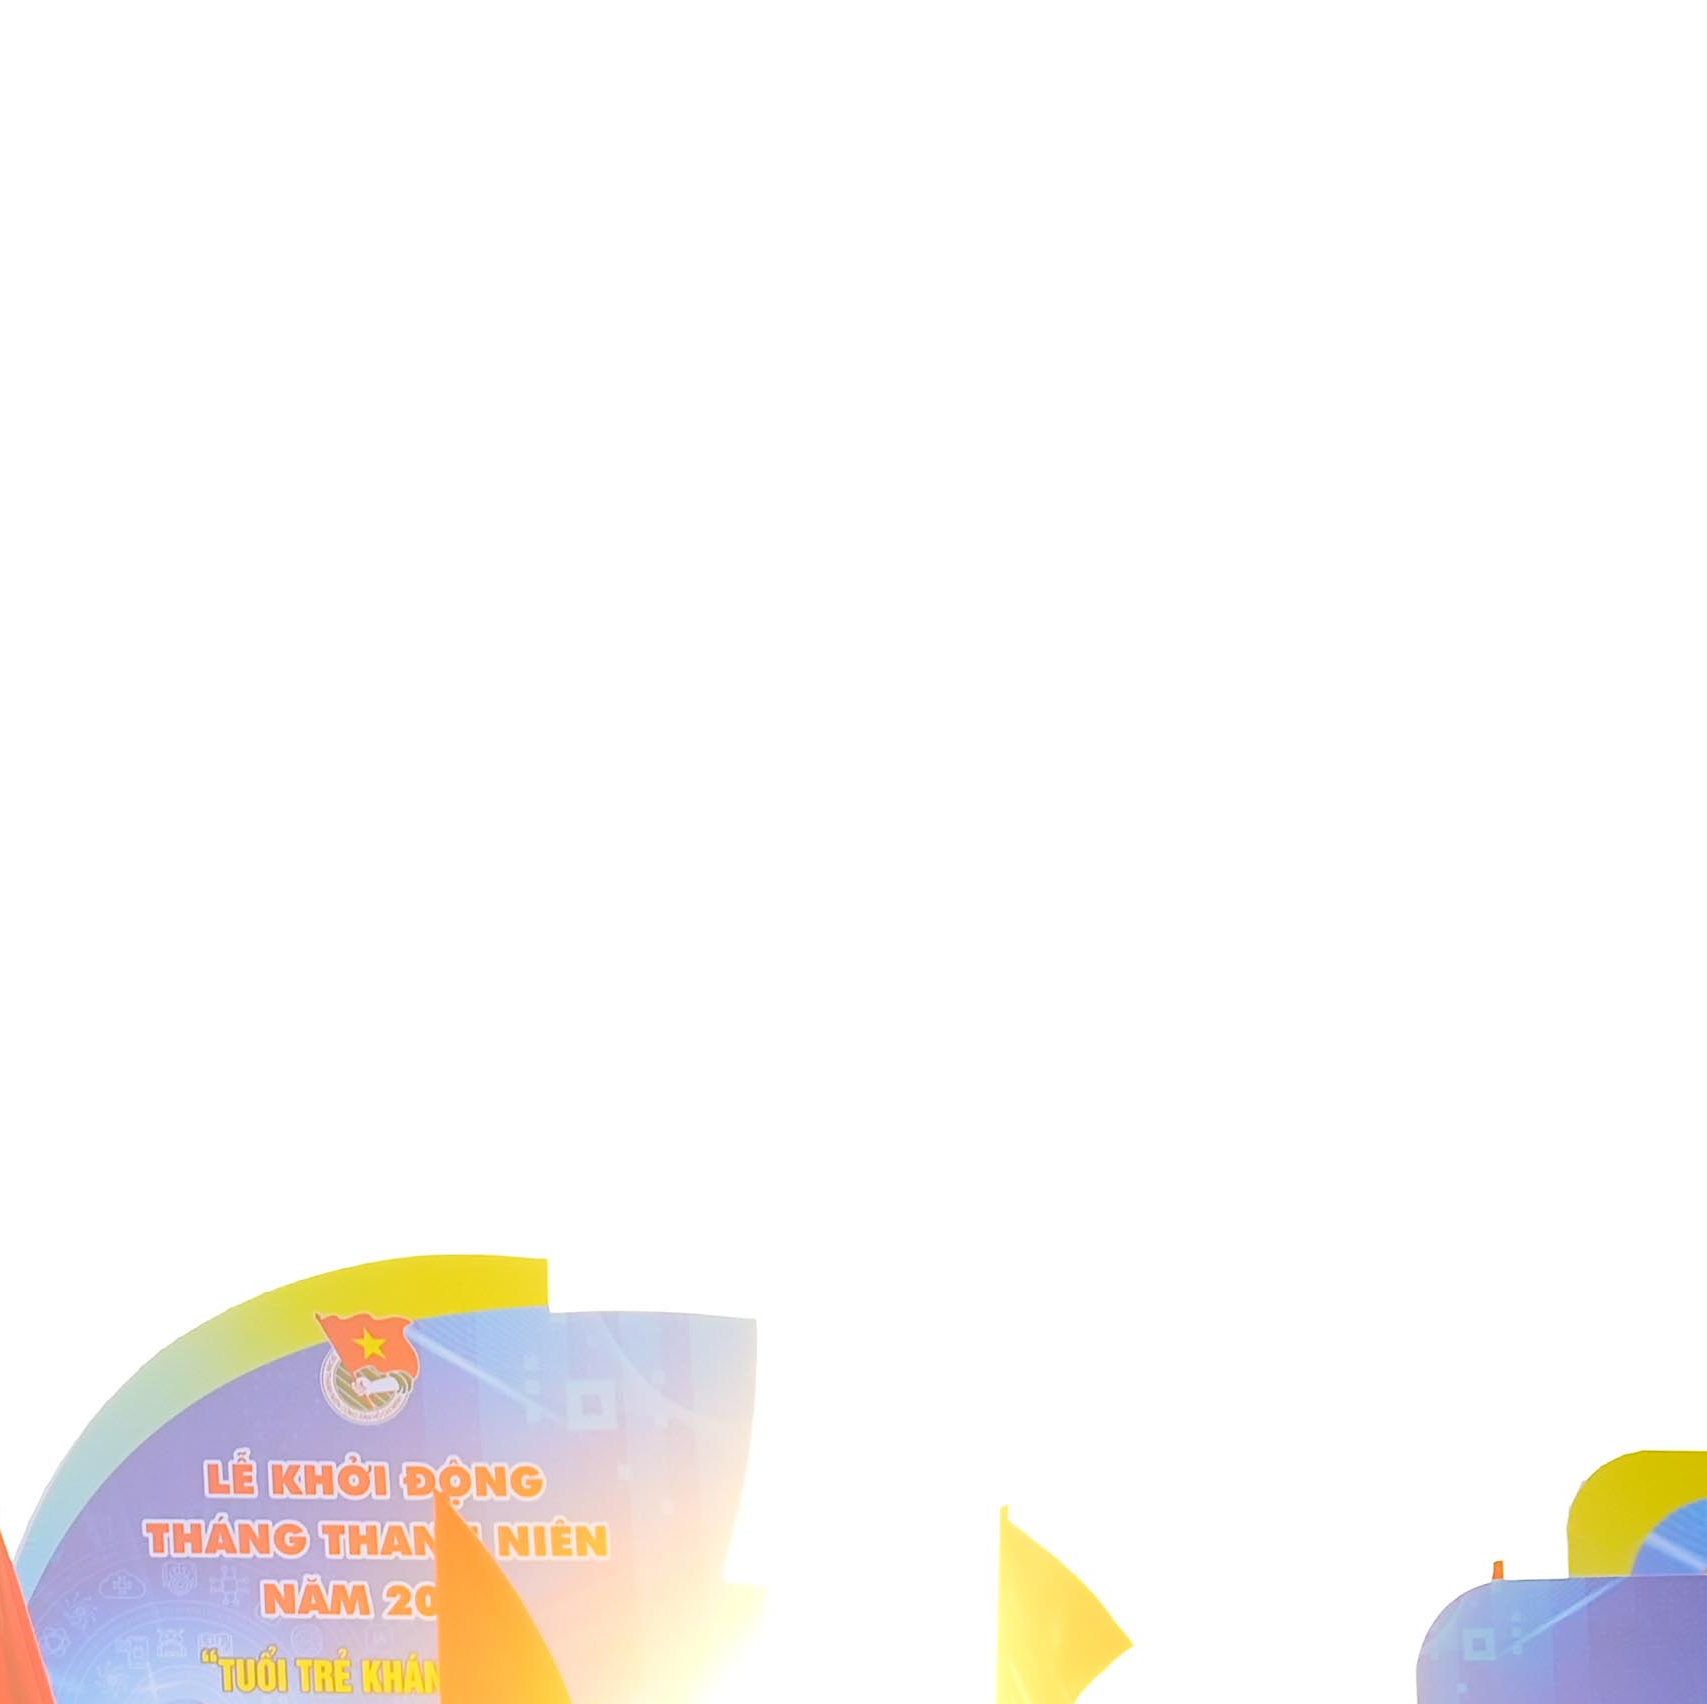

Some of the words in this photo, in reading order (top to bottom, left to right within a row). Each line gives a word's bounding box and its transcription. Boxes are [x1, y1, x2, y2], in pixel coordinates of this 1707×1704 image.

[205, 1450, 257, 1496] LỄ
[270, 1455, 389, 1497] KHỞI
[402, 1458, 545, 1505] ĐỘNG
[145, 1513, 309, 1557] THÁNG
[320, 1522, 481, 1559] THAN
[497, 1518, 609, 1558] NIÊN
[262, 1574, 372, 1617] NĂM
[384, 1584, 438, 1617] 20
[294, 1647, 354, 1694] TRẺ
